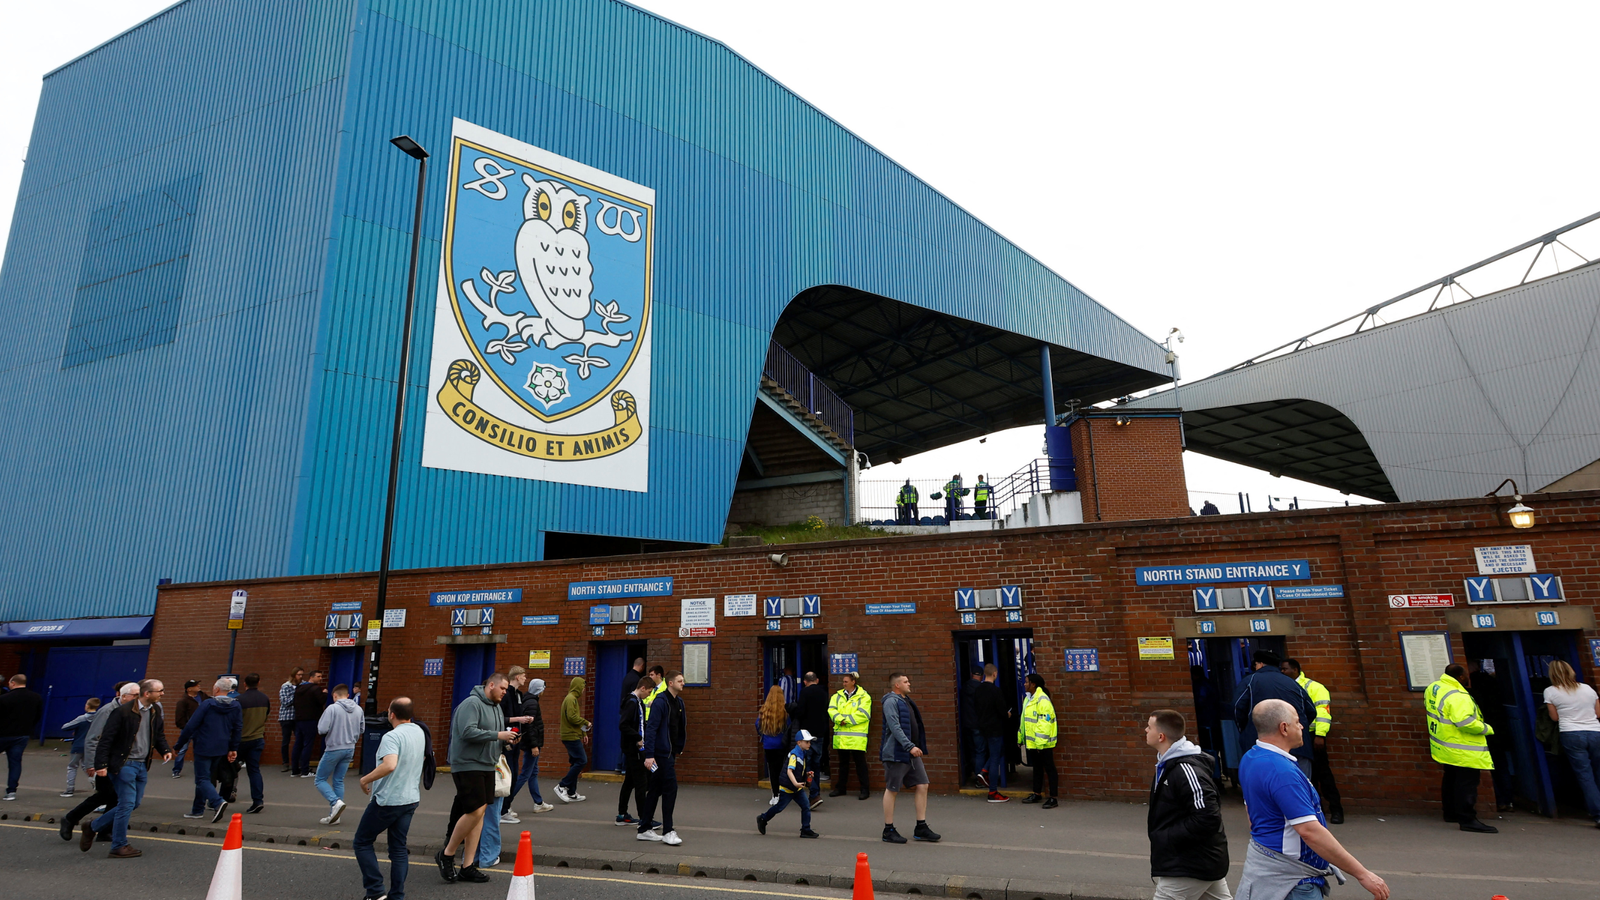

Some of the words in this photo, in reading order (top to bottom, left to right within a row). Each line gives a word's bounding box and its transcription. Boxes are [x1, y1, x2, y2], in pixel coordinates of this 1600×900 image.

[452, 402, 537, 453] CONSILIO
[546, 440, 565, 456] ET
[572, 428, 630, 456] ANIMIS
[1143, 569, 1182, 582] NORTH
[1185, 567, 1222, 580] STAND
[1226, 565, 1289, 579] ENTRANCE
[1292, 564, 1301, 576] Y
[571, 586, 596, 596] NORTH
[597, 584, 622, 594] STAND
[624, 582, 664, 593] ENTRANCE
[665, 582, 671, 591] Y
[1468, 579, 1488, 598] Y
[1532, 577, 1552, 597] Y
[436, 594, 456, 603] SPION
[457, 593, 471, 602] KOP
[471, 592, 506, 601] ENTRANCE
[507, 591, 513, 600] X
[958, 590, 972, 607] Y
[1002, 587, 1017, 604] Y
[1197, 588, 1214, 607] Y
[1249, 587, 1266, 605] Y
[629, 605, 639, 619] Y
[767, 598, 780, 614] Y
[804, 597, 817, 612] Y
[328, 615, 338, 628] X
[352, 614, 361, 627] X
[455, 609, 464, 623] X
[482, 608, 492, 622] X
[965, 614, 973, 623] 85
[1009, 612, 1018, 620] 86
[1479, 616, 1492, 626] 89
[1540, 613, 1554, 624] 90
[803, 619, 811, 628] 84
[1203, 622, 1212, 632] 87
[1254, 620, 1265, 631] 88
[1430, 721, 1437, 734] 41
